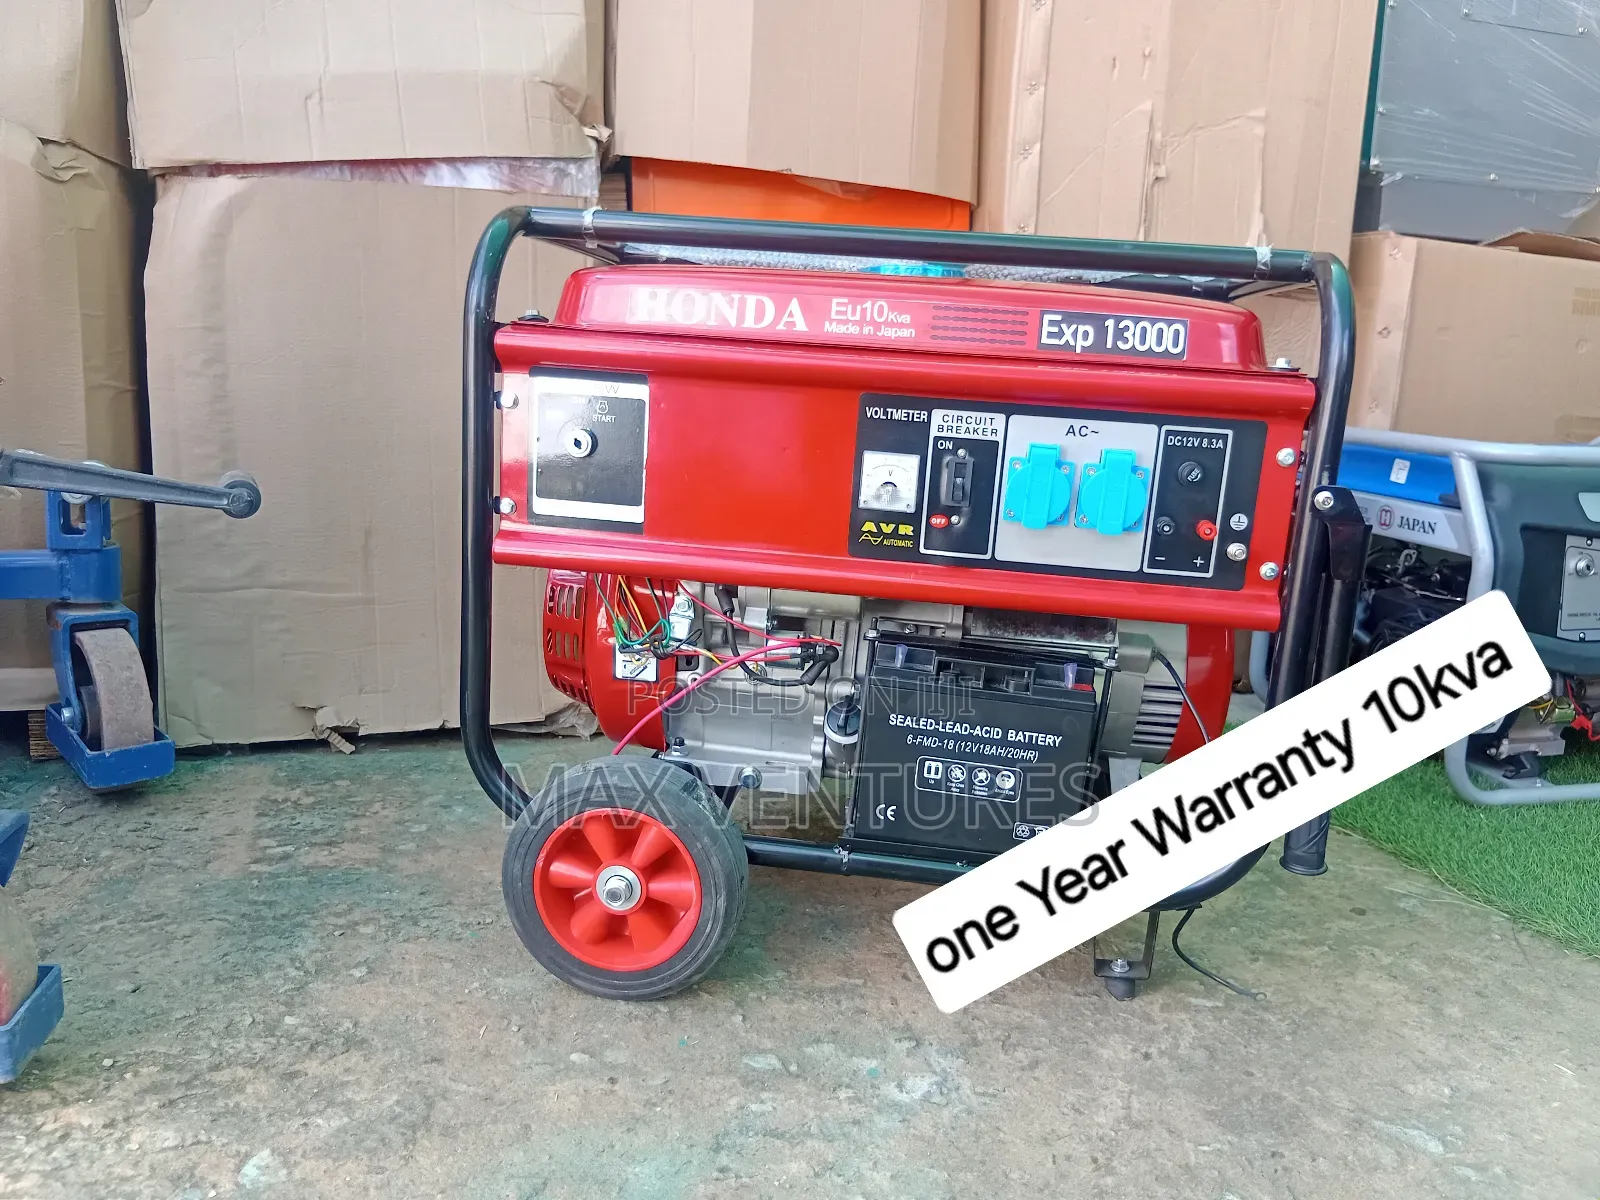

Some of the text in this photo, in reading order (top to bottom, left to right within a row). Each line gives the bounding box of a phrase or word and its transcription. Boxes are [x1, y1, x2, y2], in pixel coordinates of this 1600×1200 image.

[634, 288, 809, 332] HONDA
[824, 320, 916, 339] Made in Japan
[1040, 314, 1185, 355] Exp 13000
[592, 415, 617, 423] START
[865, 406, 928, 422] VOLTMETER
[942, 413, 996, 426] CIRCUIT
[937, 424, 998, 437] BREAKER
[937, 440, 953, 450] ON
[1167, 435, 1224, 449] DC12V 8.3A
[1187, 467, 1201, 482] FUSE
[861, 521, 914, 536] AVR
[930, 517, 946, 525] OFF
[1397, 516, 1437, 535] JAPAN
[882, 538, 914, 548] AUTOMATIC
[888, 713, 1063, 748] SEALED-LEAD-ACID BATTERY
[906, 734, 1040, 764] 6-FMD-18 (12V18AH/20HR)
